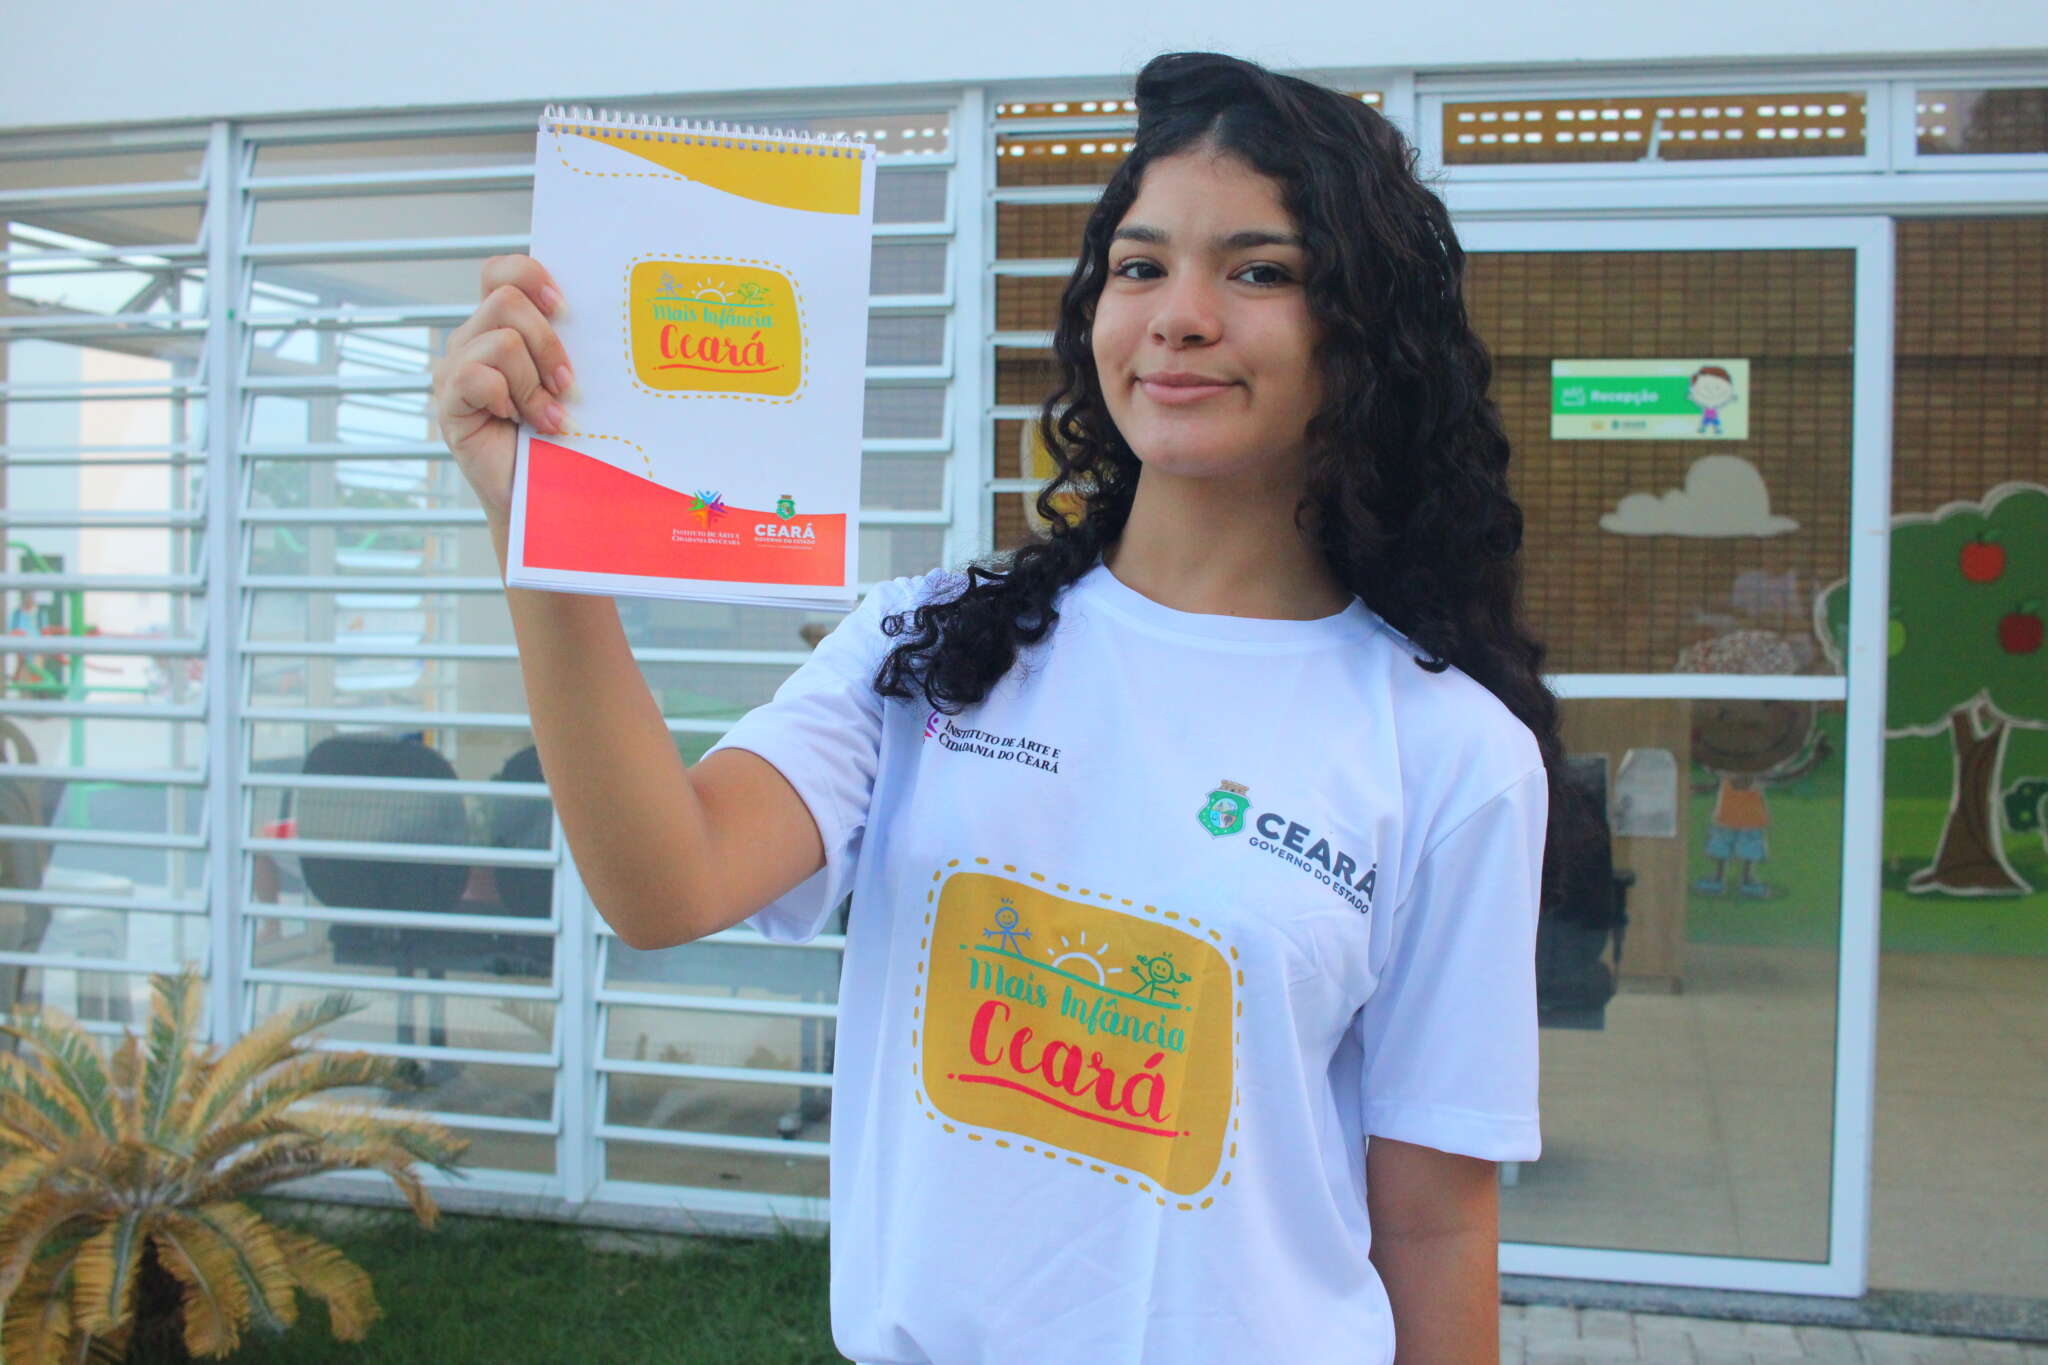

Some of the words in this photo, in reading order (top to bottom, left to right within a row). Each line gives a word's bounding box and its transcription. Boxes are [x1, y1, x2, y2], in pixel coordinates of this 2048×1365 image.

[653, 304, 698, 321] Mais
[703, 306, 773, 329] Infância
[660, 324, 769, 367] Ceará
[754, 522, 816, 539] CEARÁ
[938, 732, 994, 759] CIDADANIA
[998, 750, 1014, 761] DO
[1016, 751, 1059, 774] CEARÁ
[944, 720, 1000, 745] INSTITUTO
[1001, 737, 1016, 747] DE
[1017, 736, 1051, 755] ARTE
[1052, 749, 1061, 758] E
[1249, 837, 1312, 872] GOVERNO
[1314, 869, 1331, 885] DO
[1332, 881, 1369, 914] ESTADO
[1256, 812, 1377, 902] CEARÁ
[968, 957, 1048, 1008] Mais
[1060, 986, 1185, 1053] Infância
[969, 1000, 1171, 1123] Ceará
